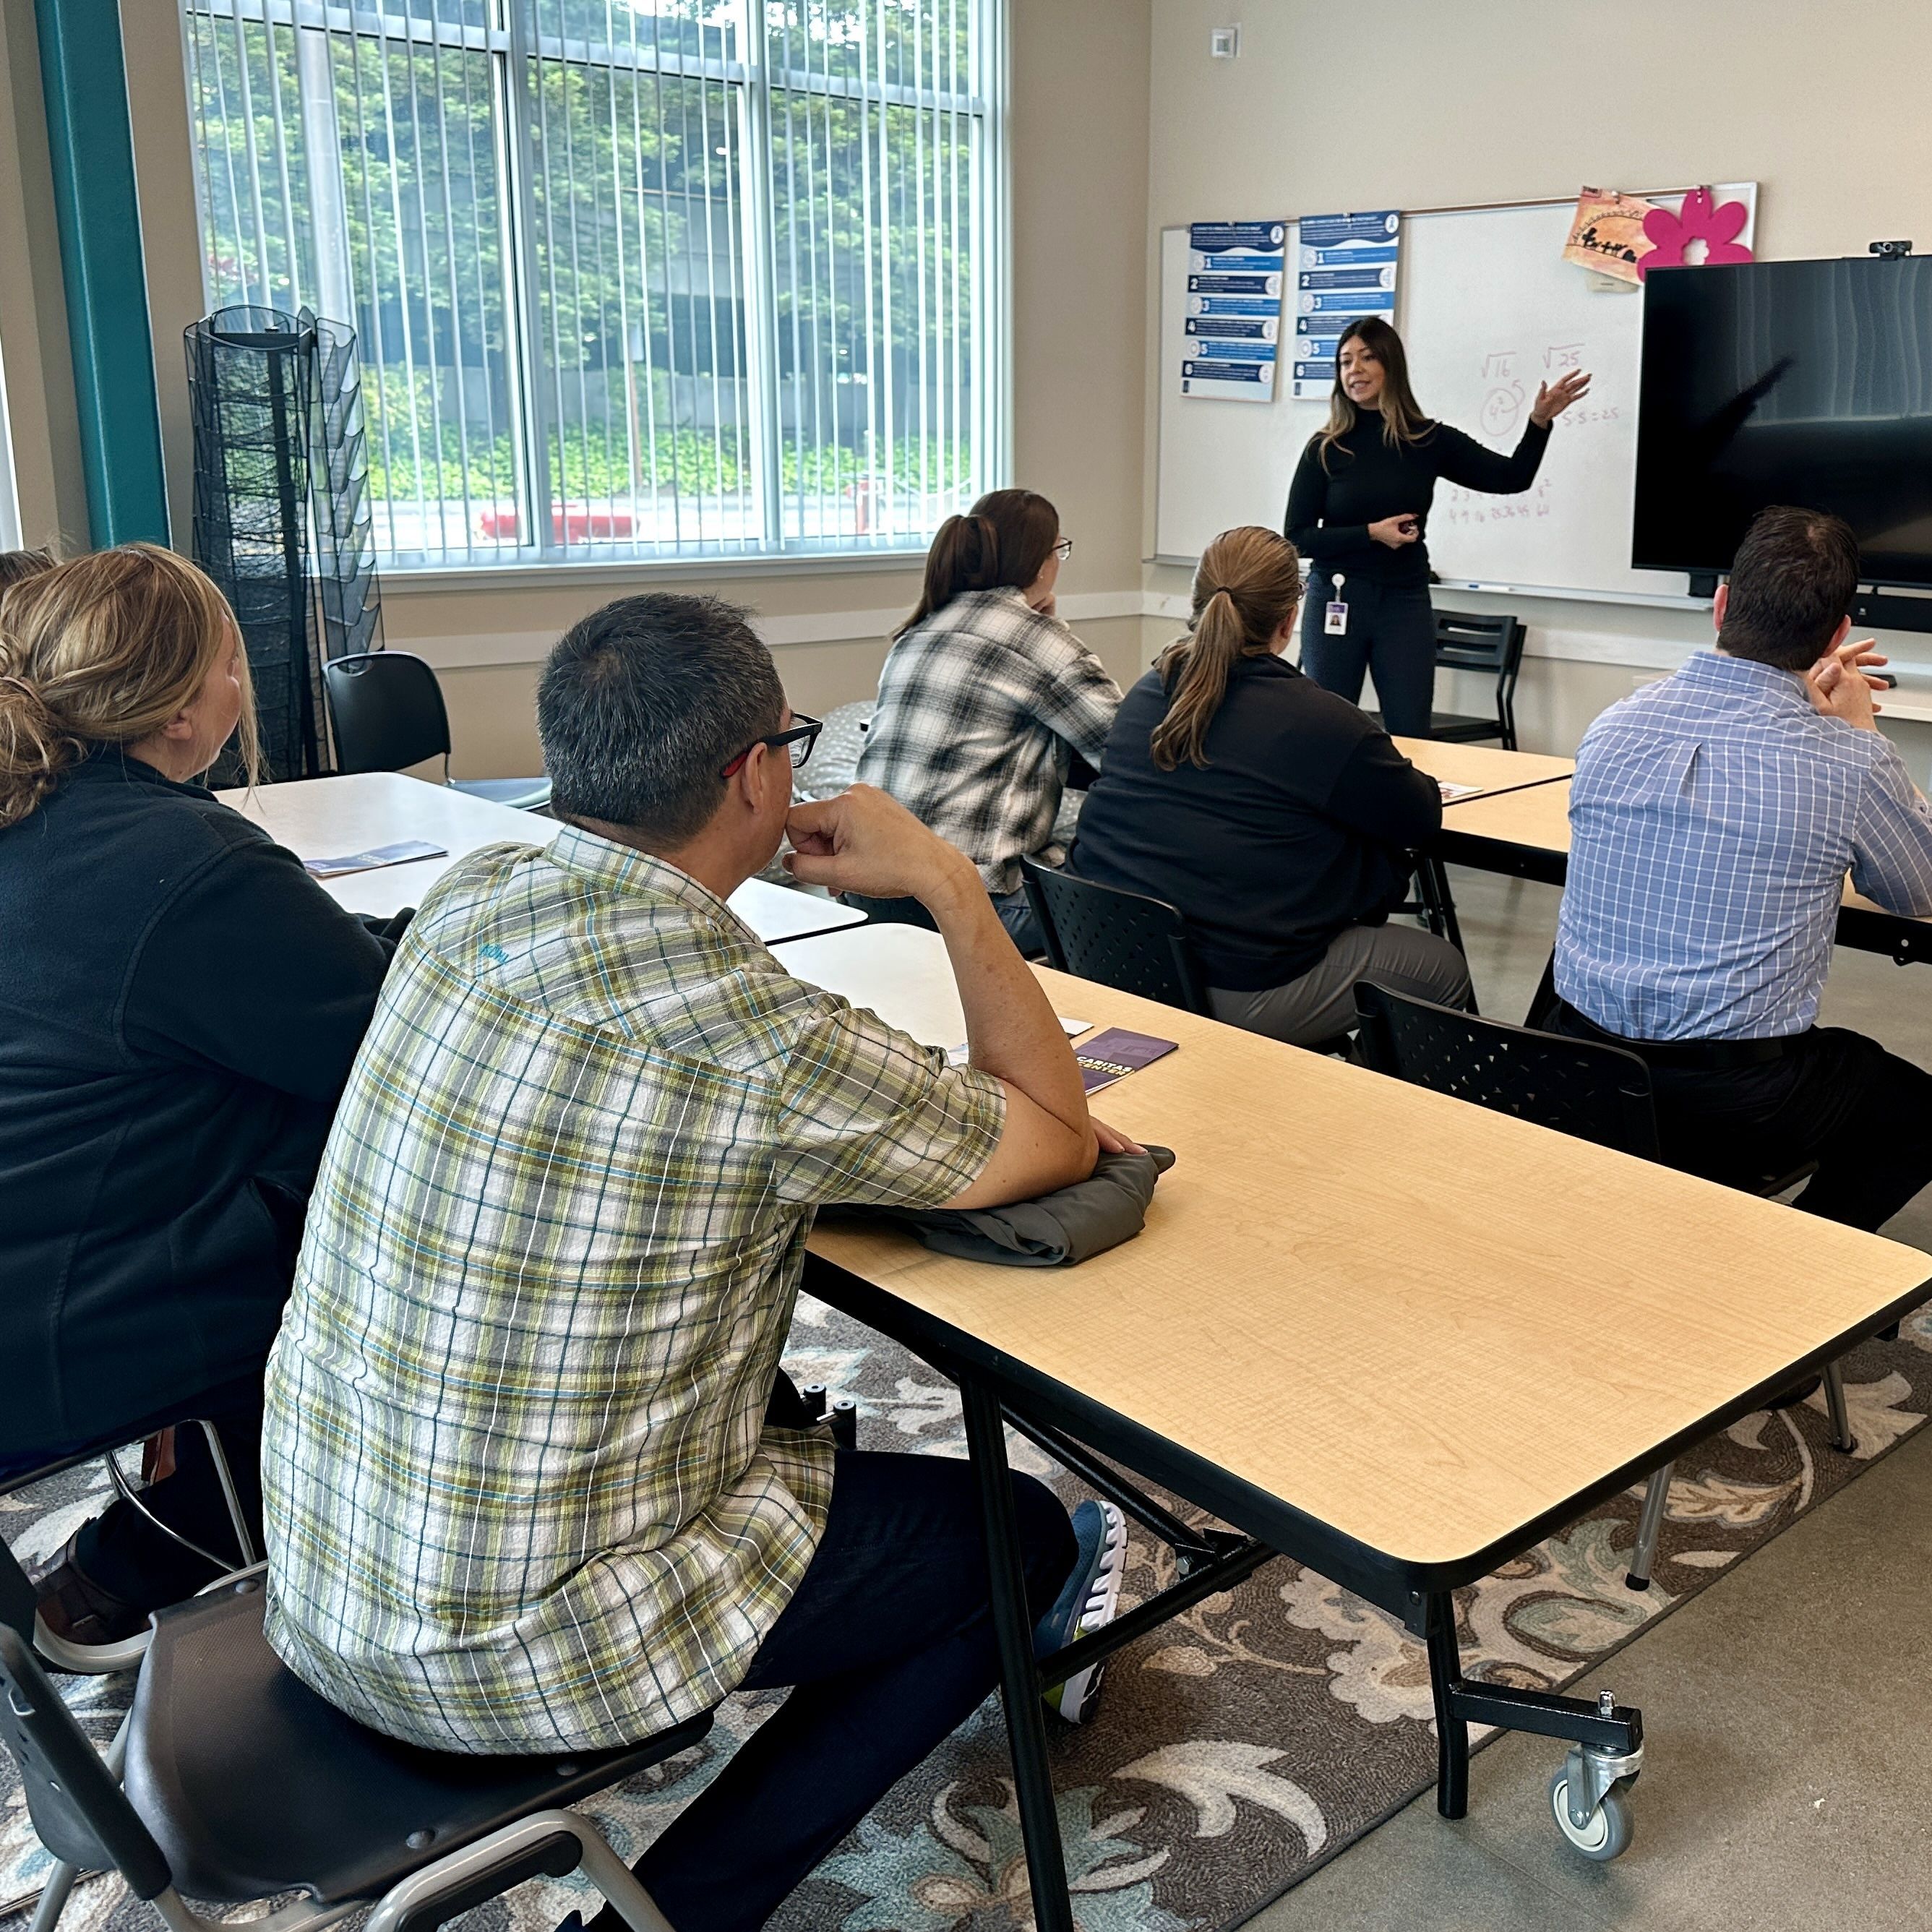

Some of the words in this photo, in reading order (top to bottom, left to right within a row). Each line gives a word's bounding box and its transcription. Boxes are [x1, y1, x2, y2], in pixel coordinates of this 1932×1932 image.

[1206, 258, 1212, 268] 1
[1318, 253, 1325, 264] 1
[1190, 278, 1198, 290] 2
[1301, 275, 1310, 287] 2
[1315, 296, 1322, 309] 3
[1188, 320, 1196, 332] 4
[1299, 319, 1308, 332] 4
[1201, 343, 1208, 355] 5
[1313, 342, 1321, 353] 5
[1076, 1056, 1133, 1072] CARITAS
[1078, 1062, 1126, 1076] CENTER
